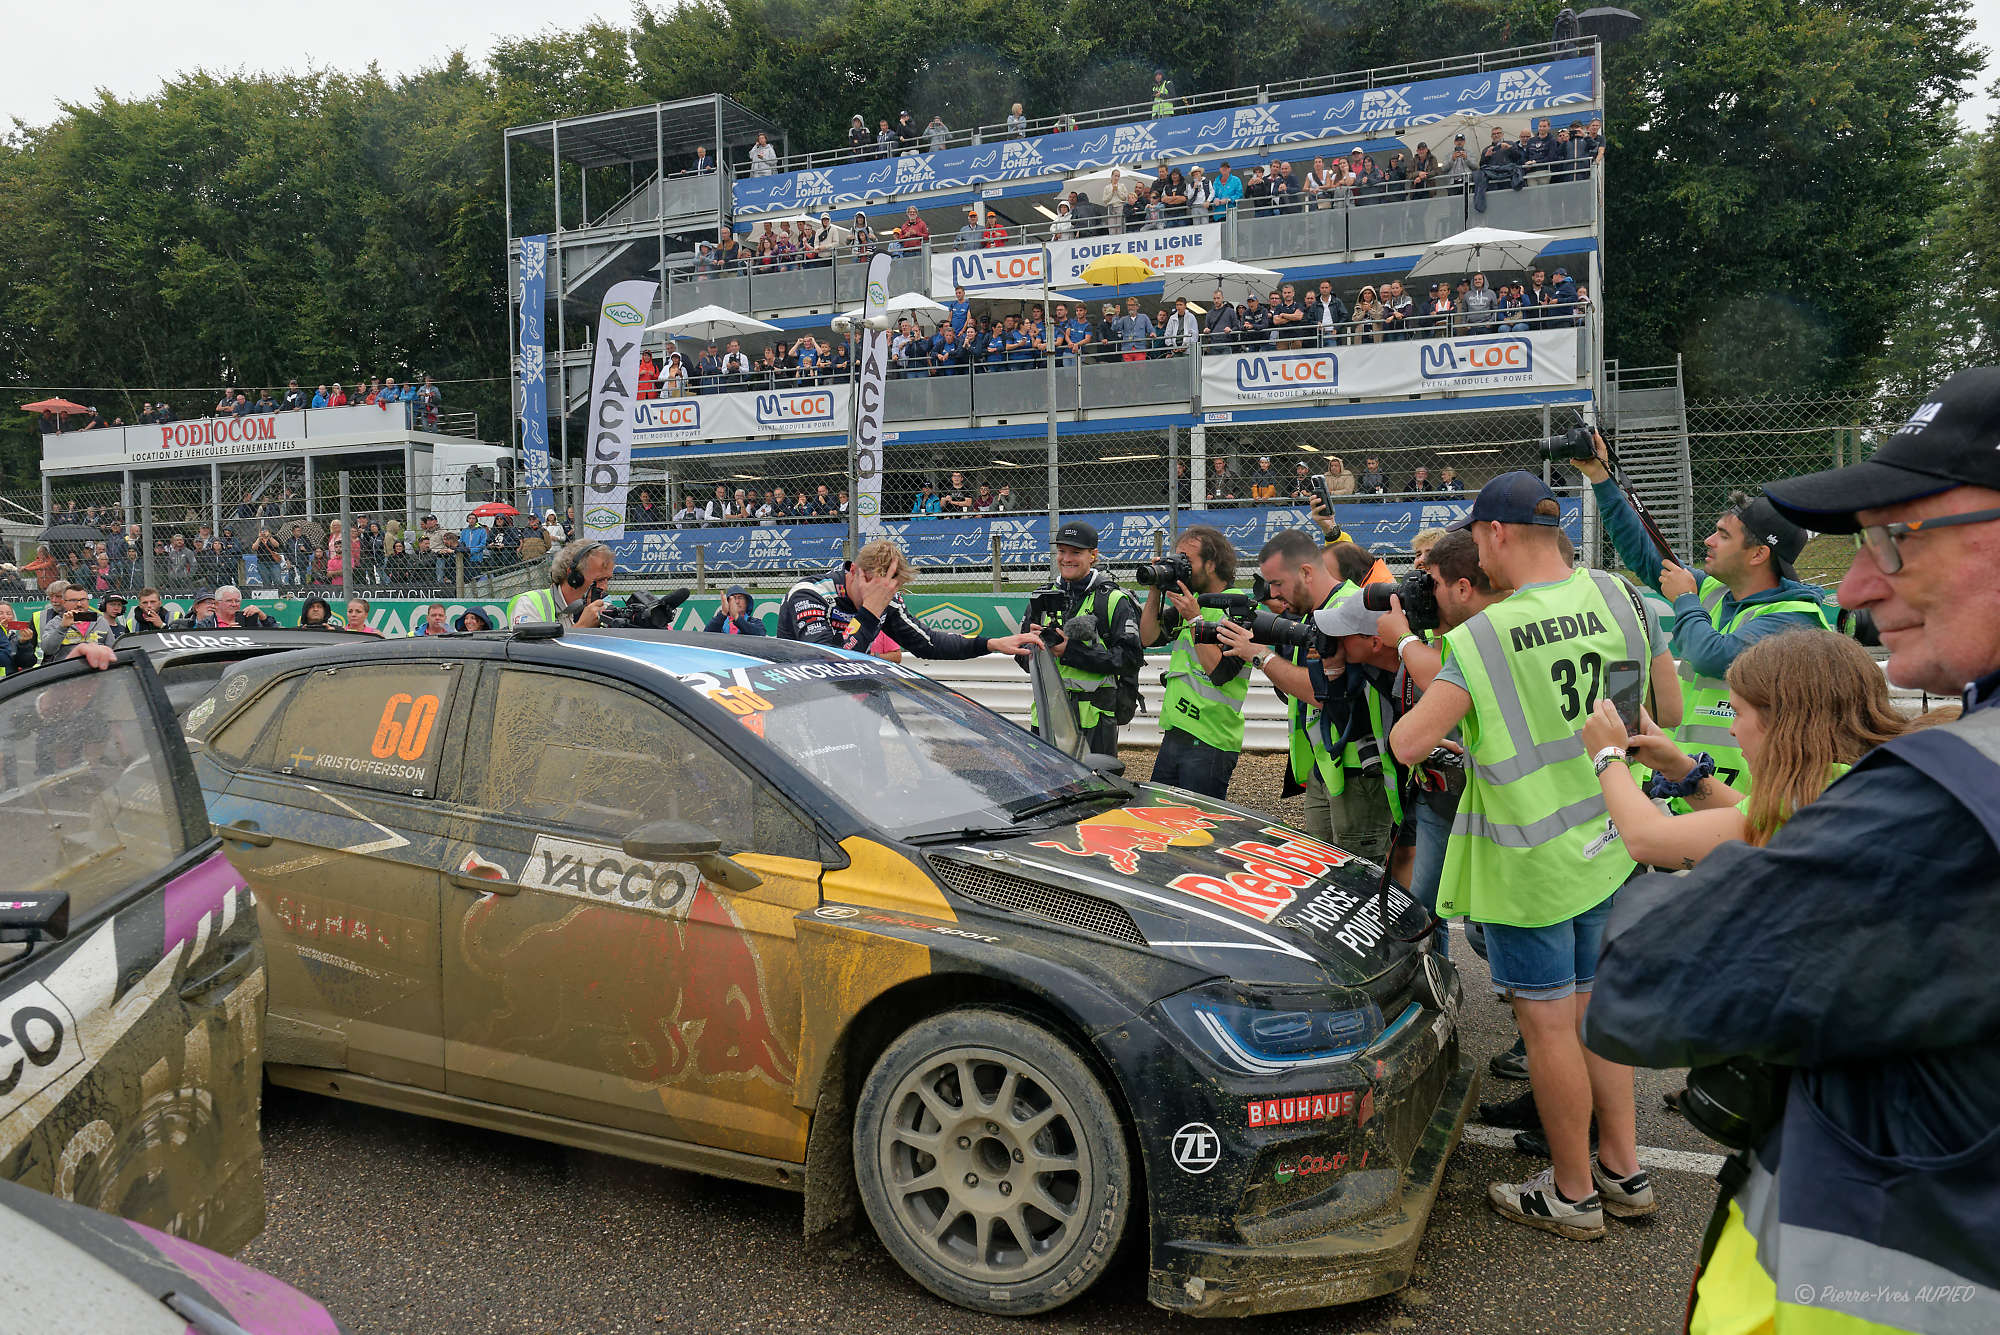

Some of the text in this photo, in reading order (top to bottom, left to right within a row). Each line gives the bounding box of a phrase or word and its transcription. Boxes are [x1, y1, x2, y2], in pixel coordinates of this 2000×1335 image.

[1498, 66, 1552, 91] RX
[1361, 86, 1412, 111] RX
[1496, 86, 1552, 102] LOHEAC
[1234, 104, 1280, 127] RX
[1360, 104, 1411, 120] LOHEAC
[1114, 122, 1158, 145] RX
[1232, 123, 1280, 138] LOHEAC
[1002, 139, 1042, 160] RX
[1112, 140, 1157, 154] LOHEAC
[897, 154, 937, 174] RX
[1001, 155, 1042, 170] LOHEAC
[797, 169, 834, 189] RX
[895, 170, 936, 184] LOHEAC
[796, 184, 834, 199] LOHEAC
[1071, 233, 1203, 260] LOUEZ EN LIGNE
[952, 254, 1041, 282] M-LOC
[607, 307, 641, 322] YACCO
[1421, 342, 1520, 370] M-LOC
[1237, 357, 1327, 383] M-LOC
[1454, 377, 1489, 386] MODULE
[1503, 374, 1533, 382] POWER
[757, 393, 825, 416] M-LOC
[1266, 390, 1300, 399] MODULE
[1311, 387, 1339, 396] POWER
[590, 338, 635, 494] YACCO
[161, 417, 277, 449] PODIOCOM
[132, 451, 171, 462] LOCATION
[173, 450, 183, 459] DE
[1631, 493, 1644, 513] Canon
[751, 529, 792, 549] RX
[988, 519, 1038, 540] RX
[642, 533, 682, 552] RX
[749, 548, 792, 558] LOHEAC
[641, 551, 682, 561] LOHEAC
[923, 617, 973, 631] YACCO
[1509, 611, 1608, 653] MEDIA
[157, 632, 263, 649] HORSE
[1405, 677, 1414, 706] Canon
[1551, 652, 1602, 722] 32
[707, 685, 775, 715] 60
[1175, 696, 1201, 721] 53
[371, 692, 440, 761] 60
[315, 753, 425, 781] KRISTOFFERSSON
[541, 849, 687, 909] YACCO
[1296, 884, 1360, 933] HORSE
[1249, 1092, 1355, 1125] BAUHAUS
[1174, 1131, 1218, 1165] ZF
[1297, 1150, 1369, 1176] Castrl
